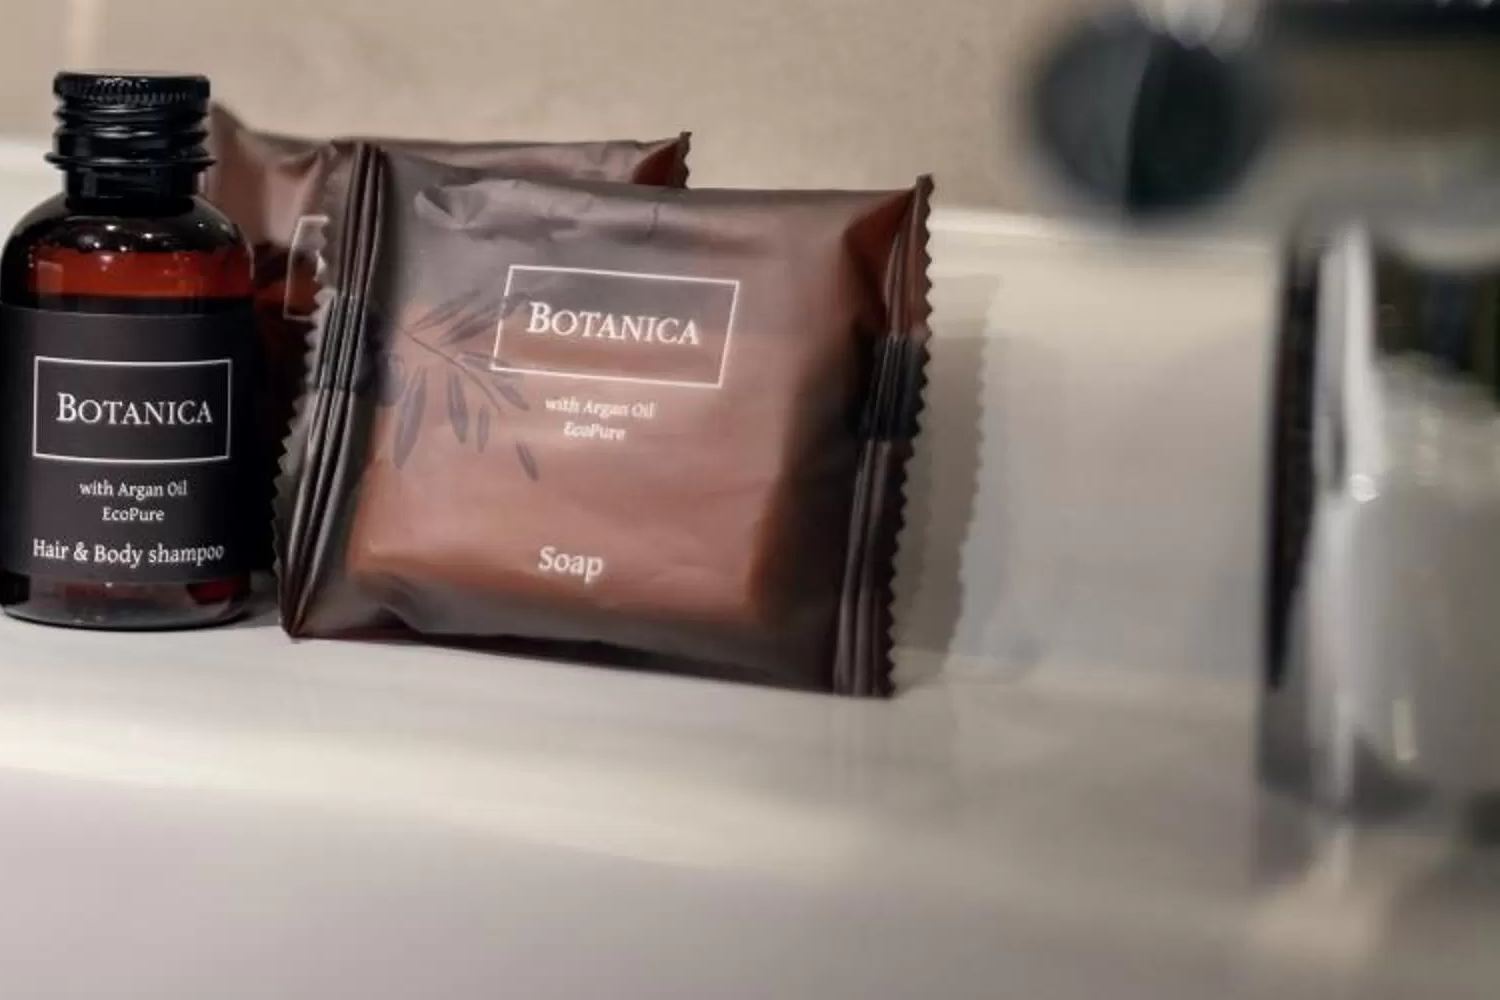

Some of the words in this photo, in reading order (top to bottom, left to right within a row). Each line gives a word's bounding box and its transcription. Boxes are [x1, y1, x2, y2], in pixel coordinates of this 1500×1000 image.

[528, 300, 700, 347] BOTANICA
[56, 392, 213, 426] BOTANICA
[545, 396, 579, 415] with
[583, 398, 629, 421] Argan
[631, 400, 655, 419] Oil
[563, 420, 626, 441] EcoPure
[79, 480, 114, 496] with
[117, 481, 163, 503] Argan
[166, 480, 188, 497] Oil
[101, 506, 165, 523] EcoPure
[33, 539, 68, 560] Hair
[73, 541, 89, 562] &
[93, 544, 143, 569] Body
[148, 544, 224, 567] shampoo
[538, 546, 604, 584] Soap
